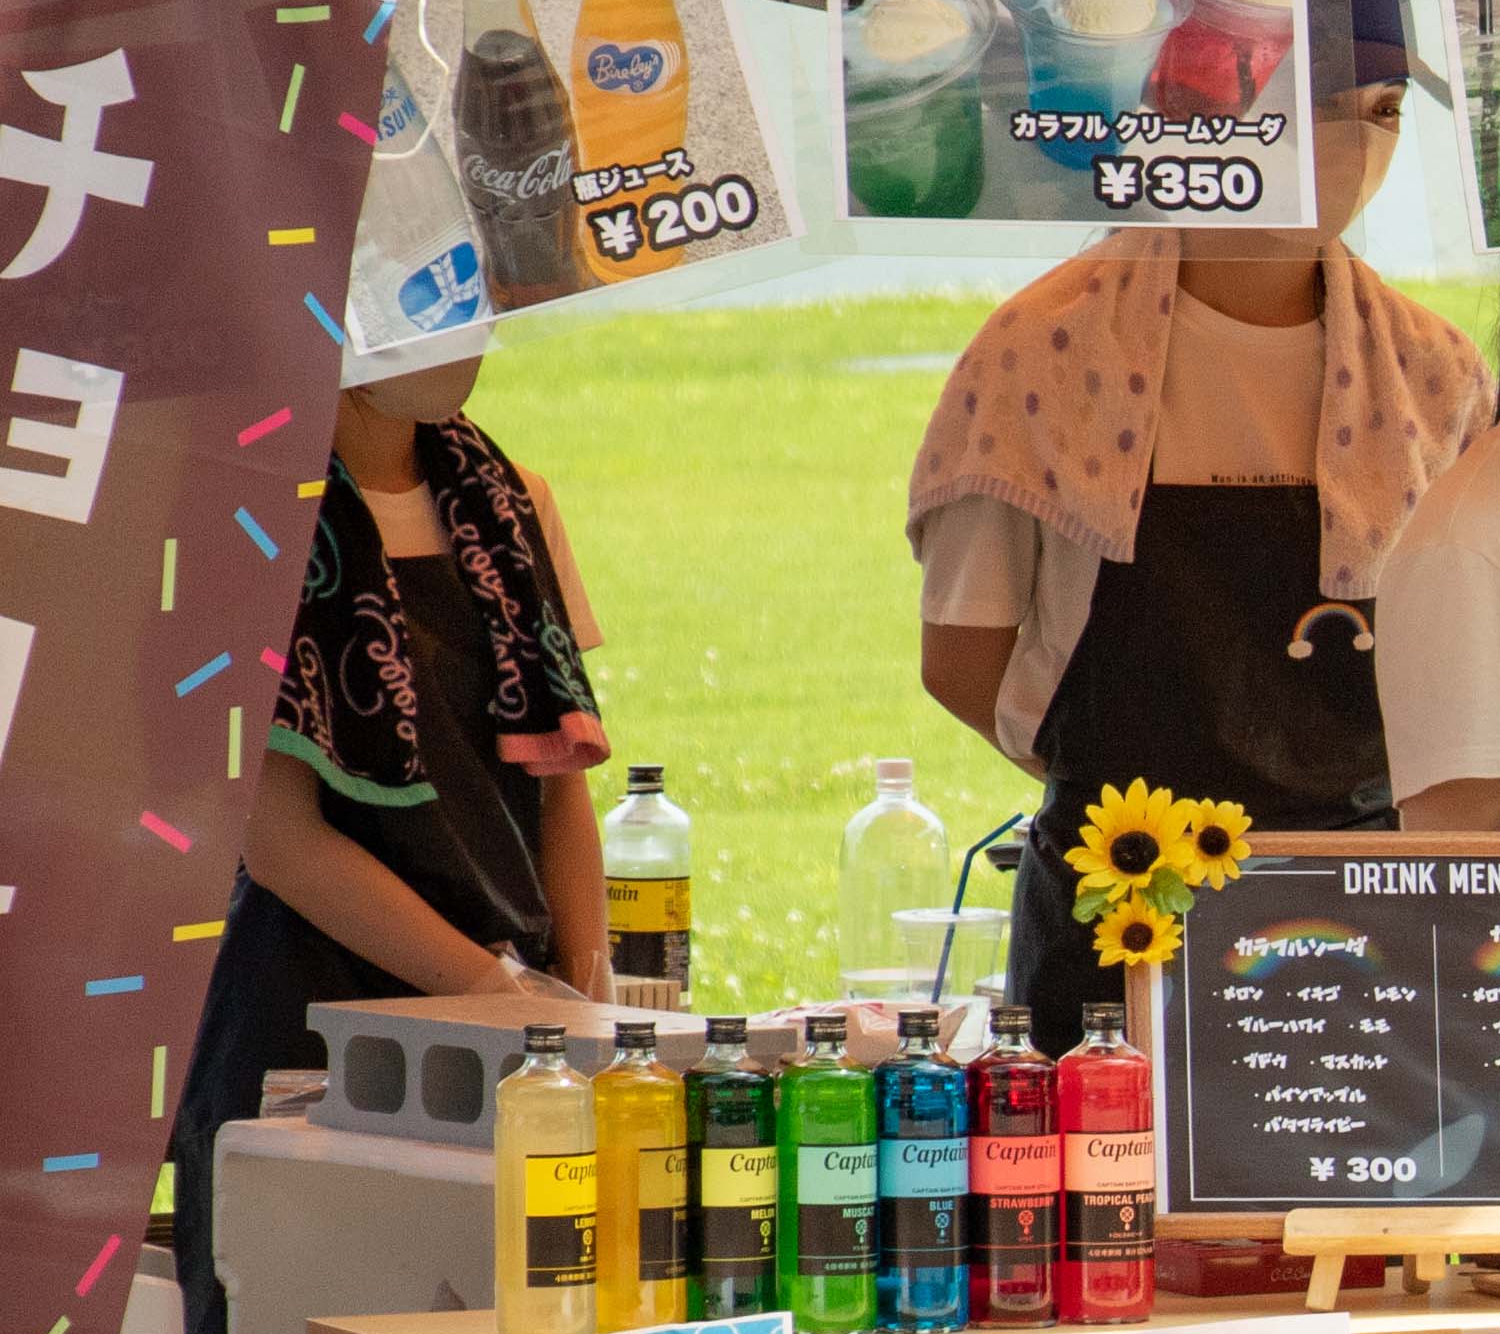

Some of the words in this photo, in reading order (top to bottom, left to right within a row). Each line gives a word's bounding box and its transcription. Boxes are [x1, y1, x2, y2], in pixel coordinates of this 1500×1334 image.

[1012, 113, 1107, 142] カラフル
[1114, 114, 1285, 145] クリームソーダ
[574, 150, 693, 201] 瓶ジュース
[1344, 863, 1437, 895] DRINK
[1233, 935, 1367, 959] カラフルソーダ
[1222, 985, 1264, 1003] メロン
[1296, 985, 1341, 1003] イチゴ
[1373, 986, 1417, 1003] レモン
[1237, 1017, 1326, 1035] ブルーハワイ
[1359, 1018, 1390, 1035] モモ
[1243, 1052, 1287, 1070] ブドウ
[1320, 1053, 1388, 1070] マスカット
[1263, 1087, 1367, 1104] パインアップル
[1263, 1115, 1366, 1134] バタフライピー
[986, 1140, 1056, 1165] Captain
[1347, 1156, 1417, 1183] 300
[929, 1201, 954, 1211] BLUE
[1084, 1194, 1134, 1205] TROPICAL
